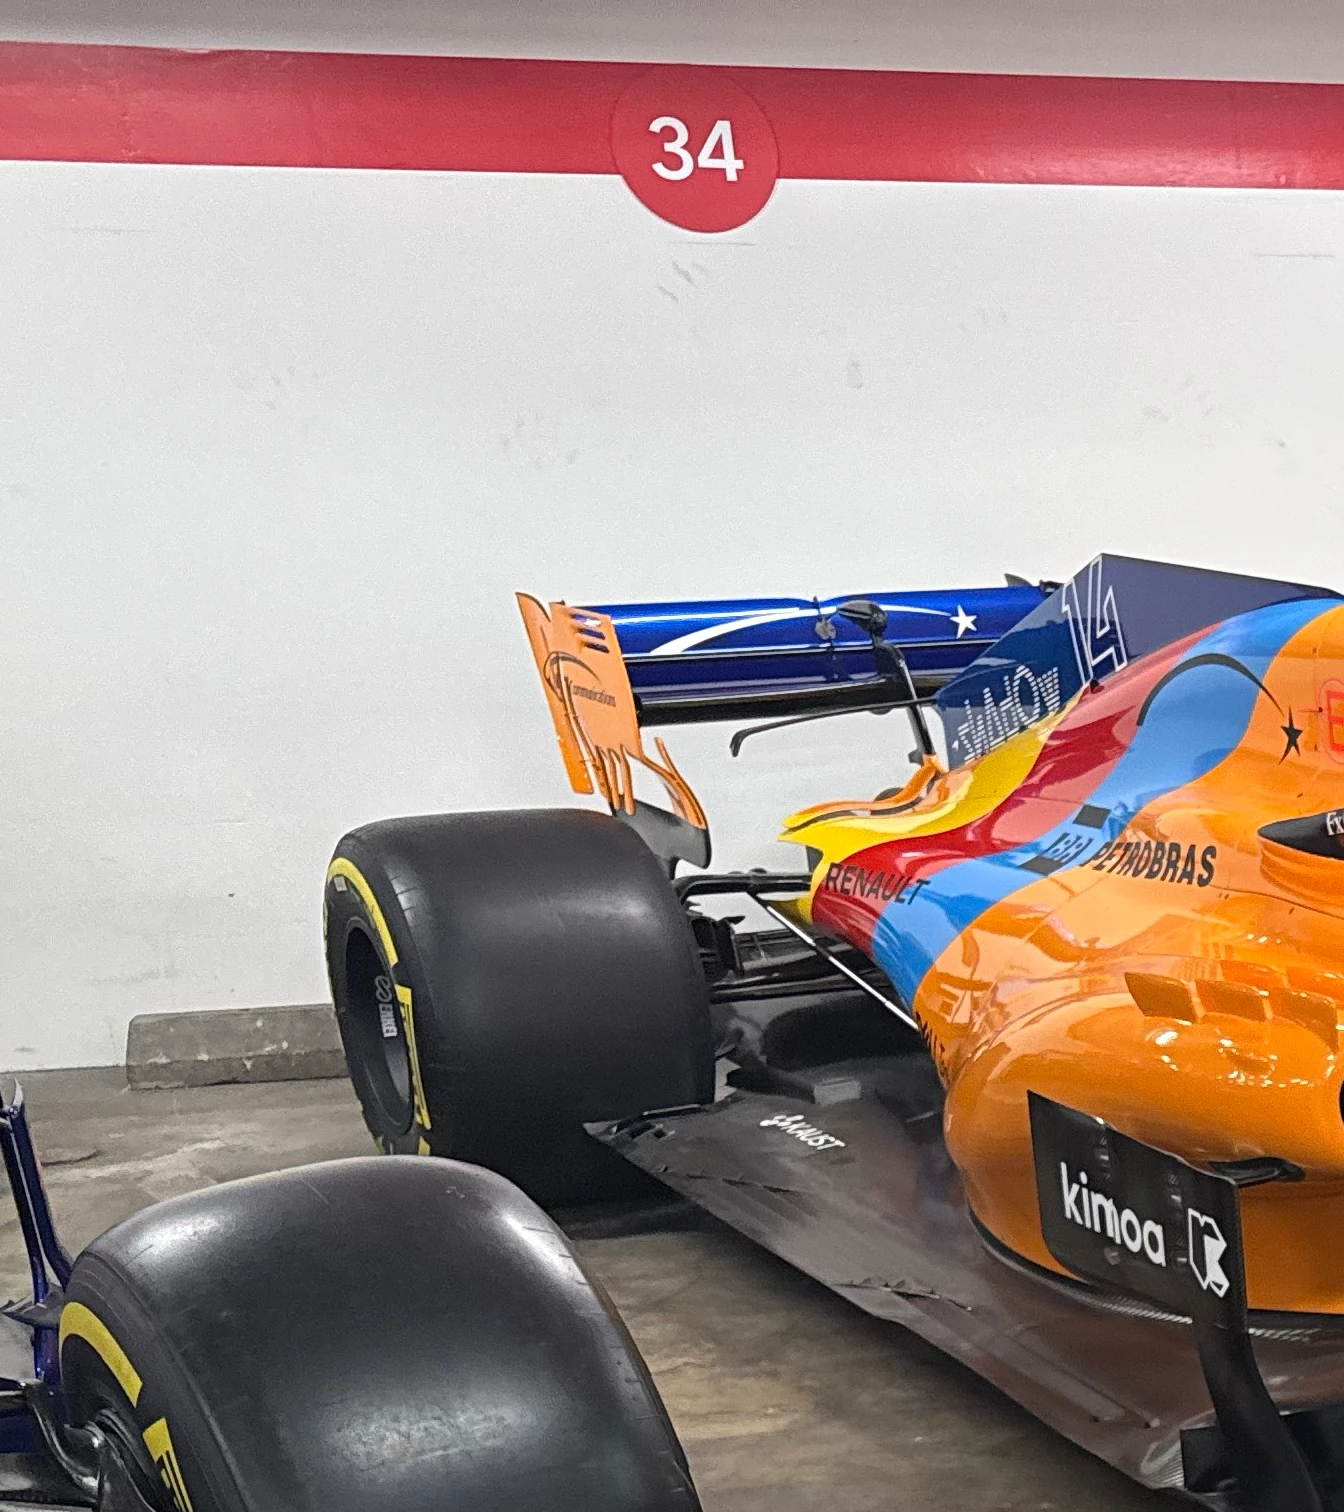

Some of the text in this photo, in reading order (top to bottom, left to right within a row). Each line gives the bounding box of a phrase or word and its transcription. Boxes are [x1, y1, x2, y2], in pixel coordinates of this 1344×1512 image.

[648, 118, 744, 184] 34
[1062, 555, 1127, 686] 14
[825, 862, 932, 906] RENAULT
[1081, 840, 1218, 888] PETROBRAS
[1060, 1161, 1167, 1268] kimoa
